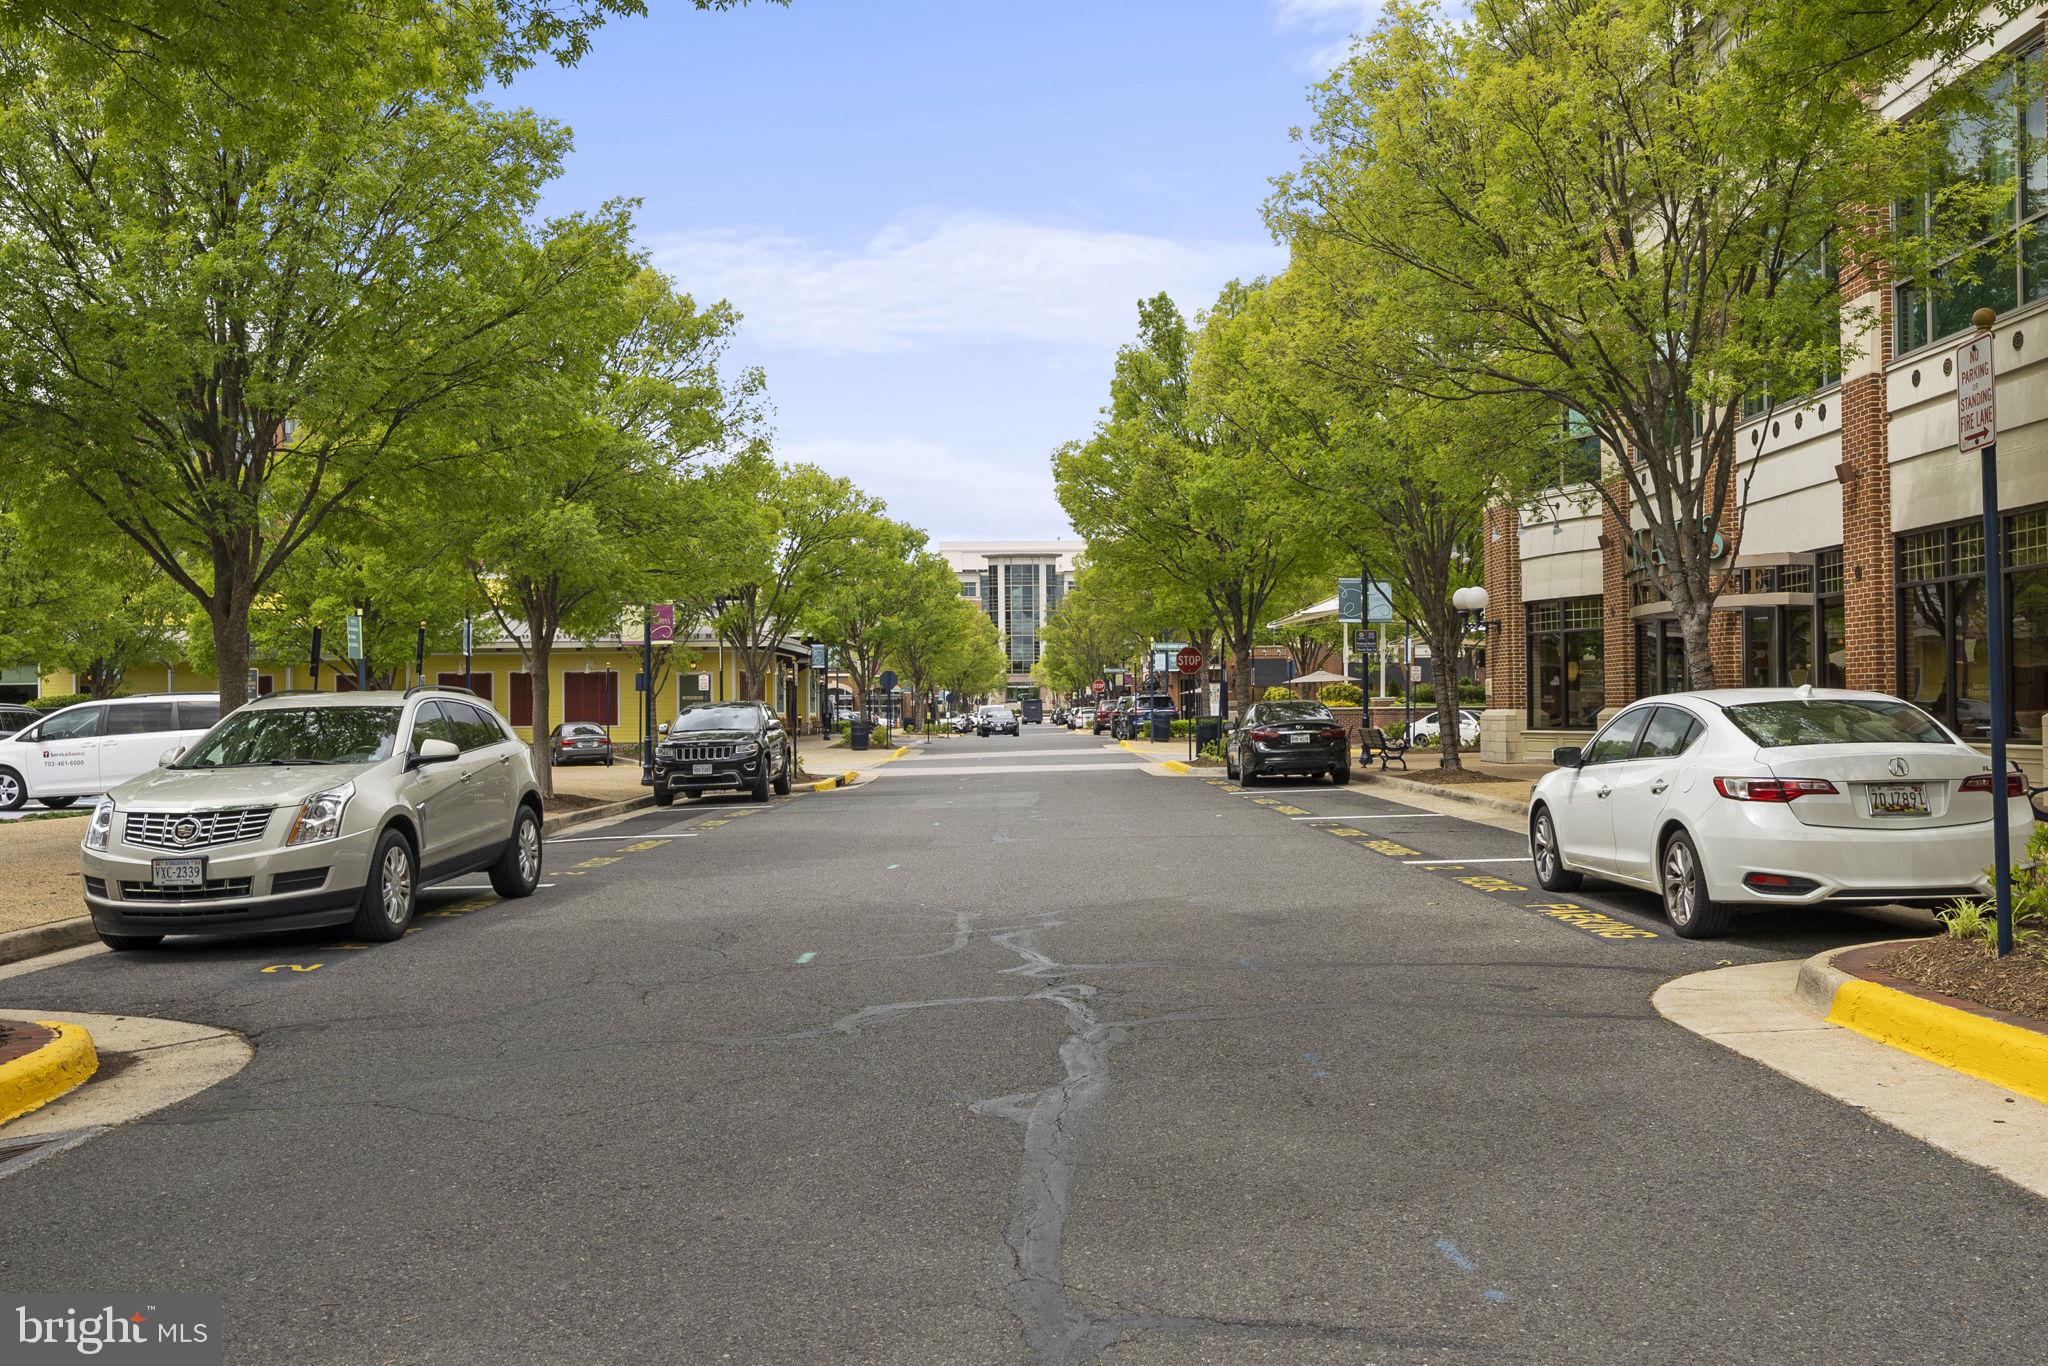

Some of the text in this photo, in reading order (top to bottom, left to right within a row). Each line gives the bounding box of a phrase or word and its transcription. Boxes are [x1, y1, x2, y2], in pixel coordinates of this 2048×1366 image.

[1969, 350, 1979, 364] NO
[1961, 362, 1989, 385] PARKING
[1960, 388, 1992, 412] STANDING
[1960, 405, 1993, 433] FIRE LANE
[1177, 655, 1201, 666] STOP
[155, 866, 200, 879] VXC-2339
[1526, 903, 1659, 939] PARKING
